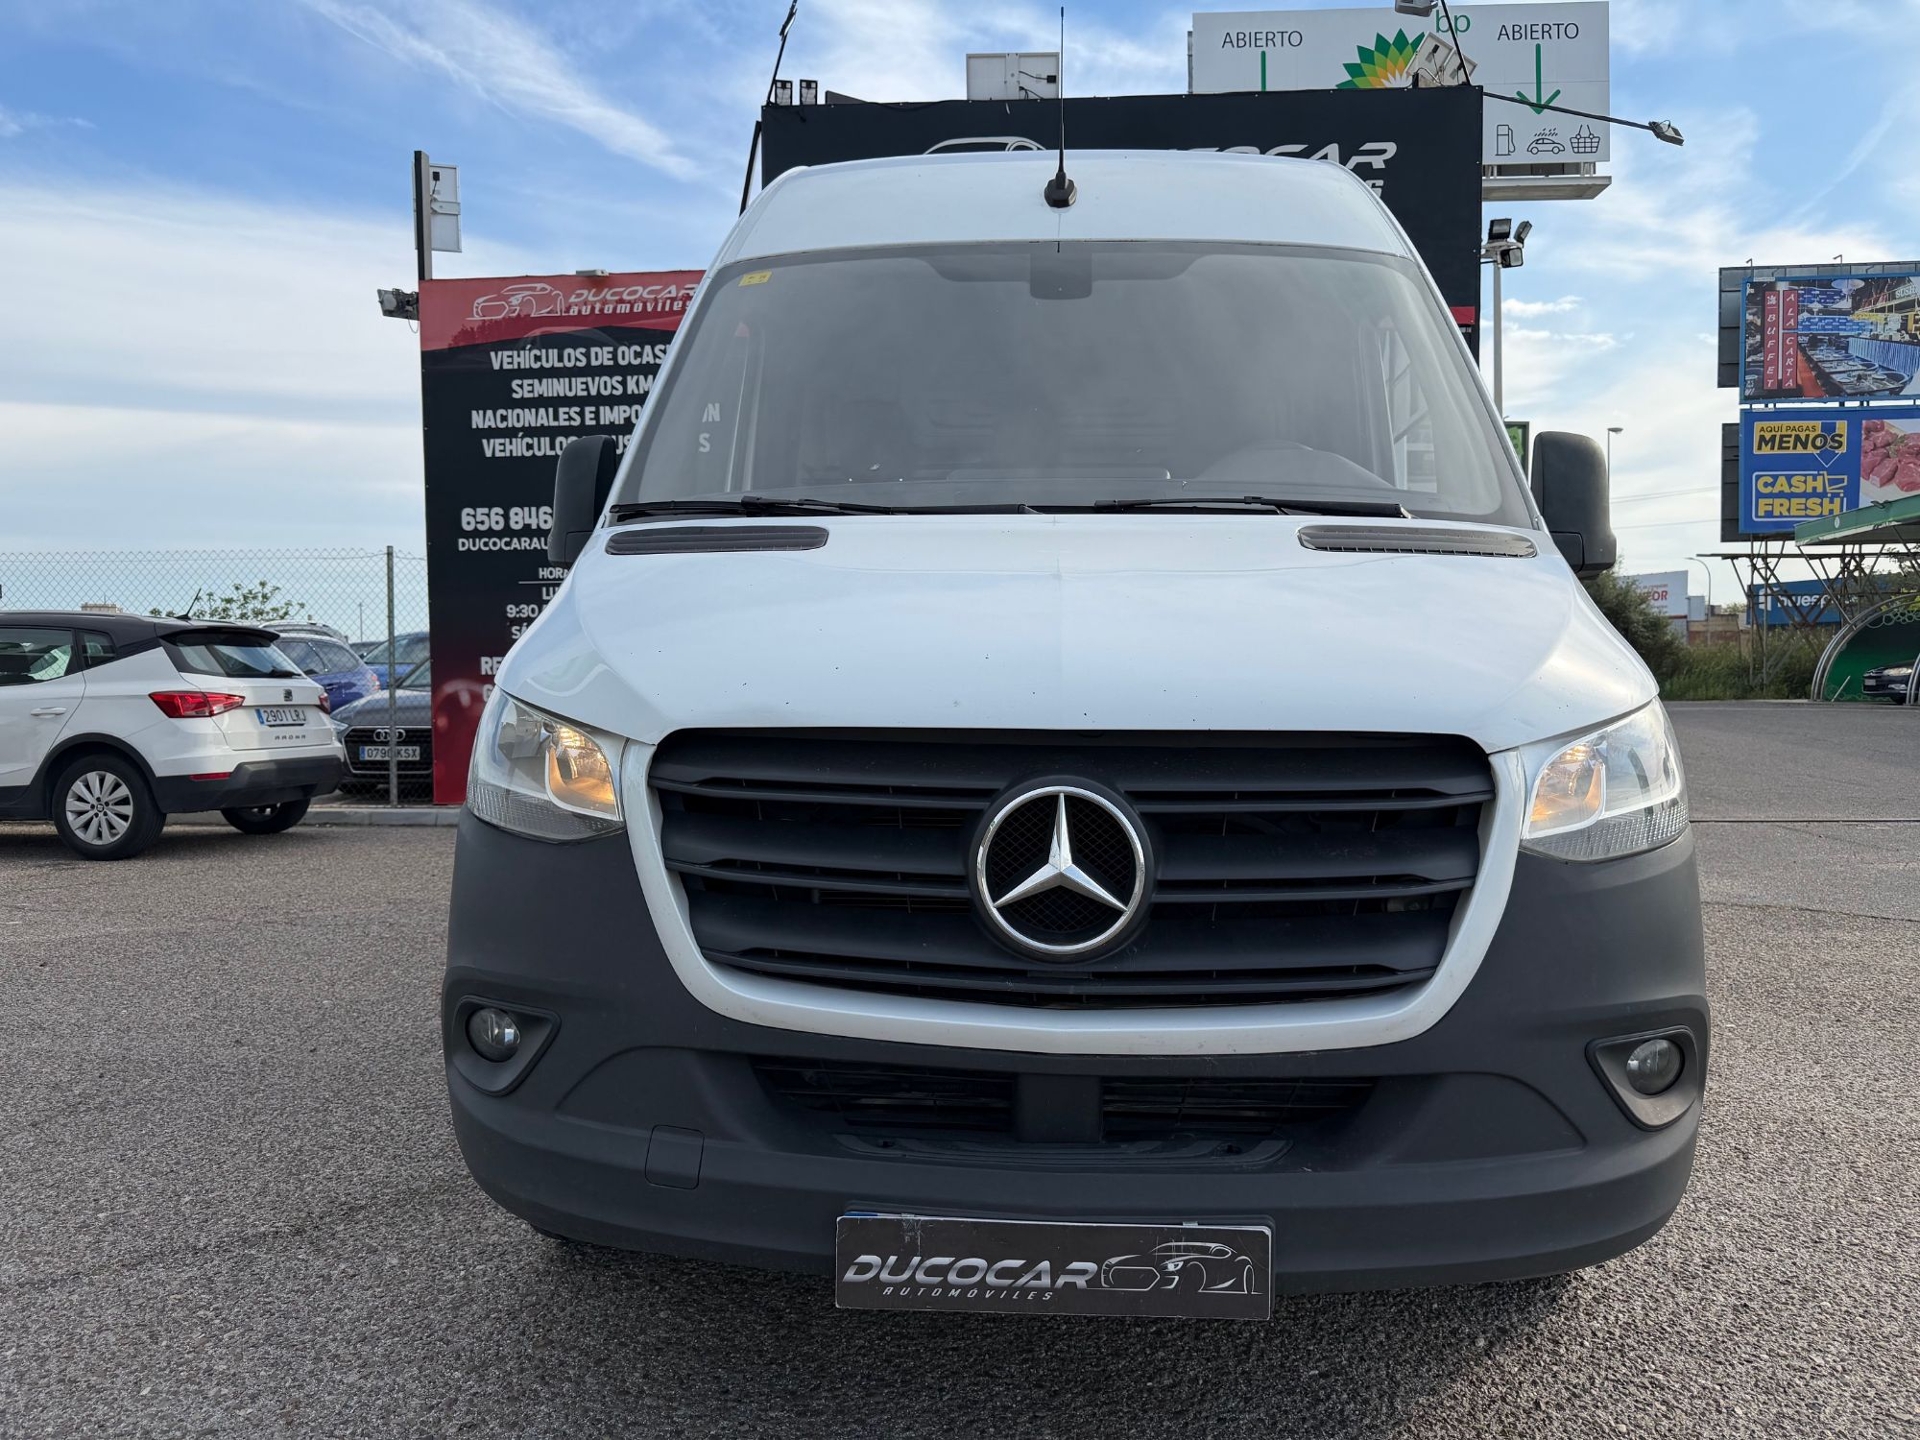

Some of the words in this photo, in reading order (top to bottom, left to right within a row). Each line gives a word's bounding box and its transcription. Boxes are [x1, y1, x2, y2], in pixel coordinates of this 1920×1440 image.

[1436, 9, 1471, 36] bp
[1497, 22, 1579, 41] ABIERTO
[1221, 30, 1303, 48] ABIERTO
[569, 284, 699, 303] DUCOCAR
[490, 344, 587, 370] VEHÍCULOS
[590, 347, 614, 366] DE
[617, 344, 670, 366] OCAS
[1766, 314, 1777, 388] BUFFET
[1784, 336, 1795, 387] CARTA
[511, 375, 623, 399] SEMINUEVOS
[471, 406, 581, 429] NACIONALES
[584, 406, 597, 425] E
[599, 404, 642, 425] IMPO
[1759, 424, 1783, 433] AQUÍ
[1786, 425, 1816, 433] PAGAS
[1757, 433, 1843, 451] MENOS
[1757, 475, 1823, 494] CASH
[1757, 497, 1841, 517] FRESH
[461, 506, 504, 531] 656
[509, 506, 553, 531] 846
[458, 537, 549, 551] DUCOCARAU
[506, 604, 539, 618] 9:30
[263, 709, 289, 723] 2901
[288, 709, 307, 722] LRJ
[842, 1254, 1099, 1289] DUCOCAR
[883, 1286, 1053, 1301] AUTOMÓVILES
